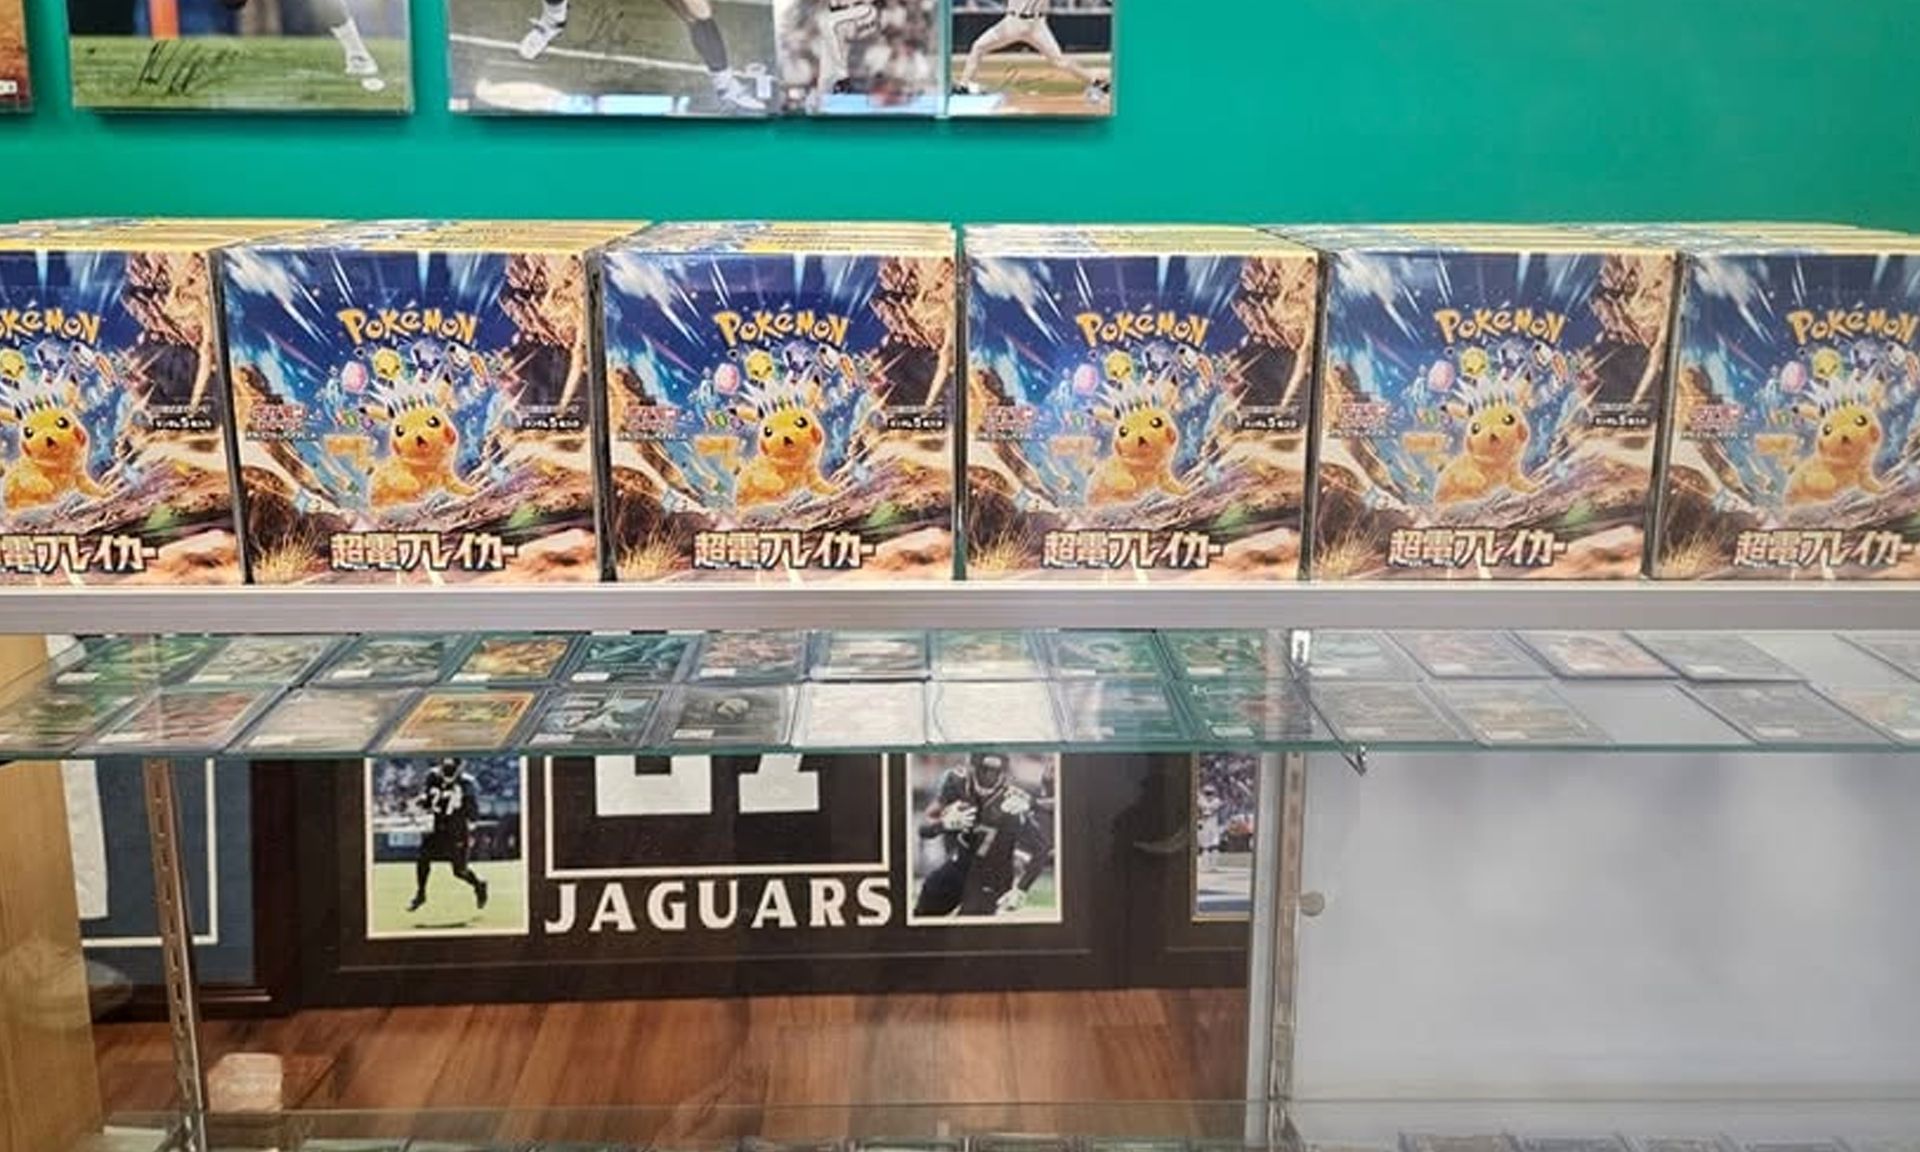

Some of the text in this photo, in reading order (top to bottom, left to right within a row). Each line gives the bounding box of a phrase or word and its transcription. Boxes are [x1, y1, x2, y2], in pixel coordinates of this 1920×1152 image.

[0, 534, 157, 573] 電ブレイカー
[544, 877, 892, 933] JAGUARS
